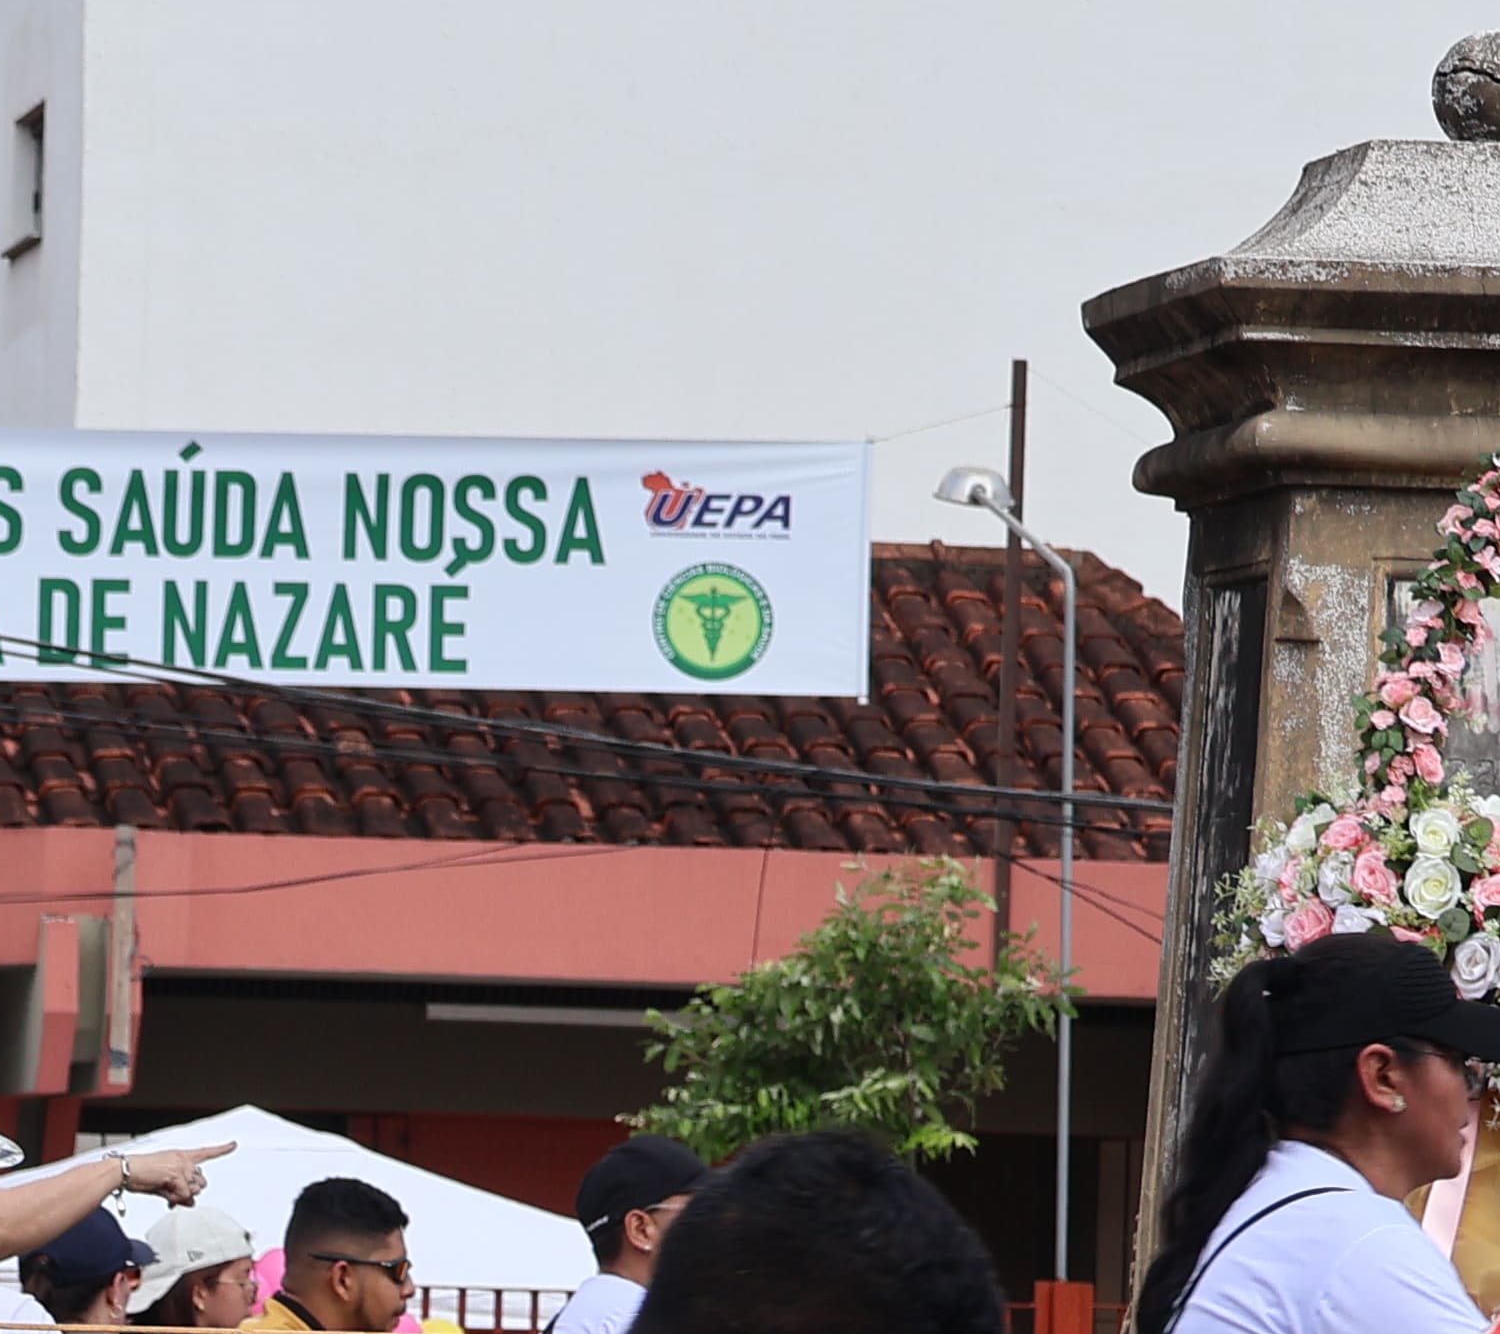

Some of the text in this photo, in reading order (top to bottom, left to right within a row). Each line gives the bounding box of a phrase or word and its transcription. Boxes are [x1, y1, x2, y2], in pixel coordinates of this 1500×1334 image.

[58, 443, 309, 561] SAÚDA
[343, 473, 606, 566] NOSSA
[651, 493, 791, 529] UEPA
[39, 578, 131, 668] DE
[161, 539, 469, 674] NAZARÉ
